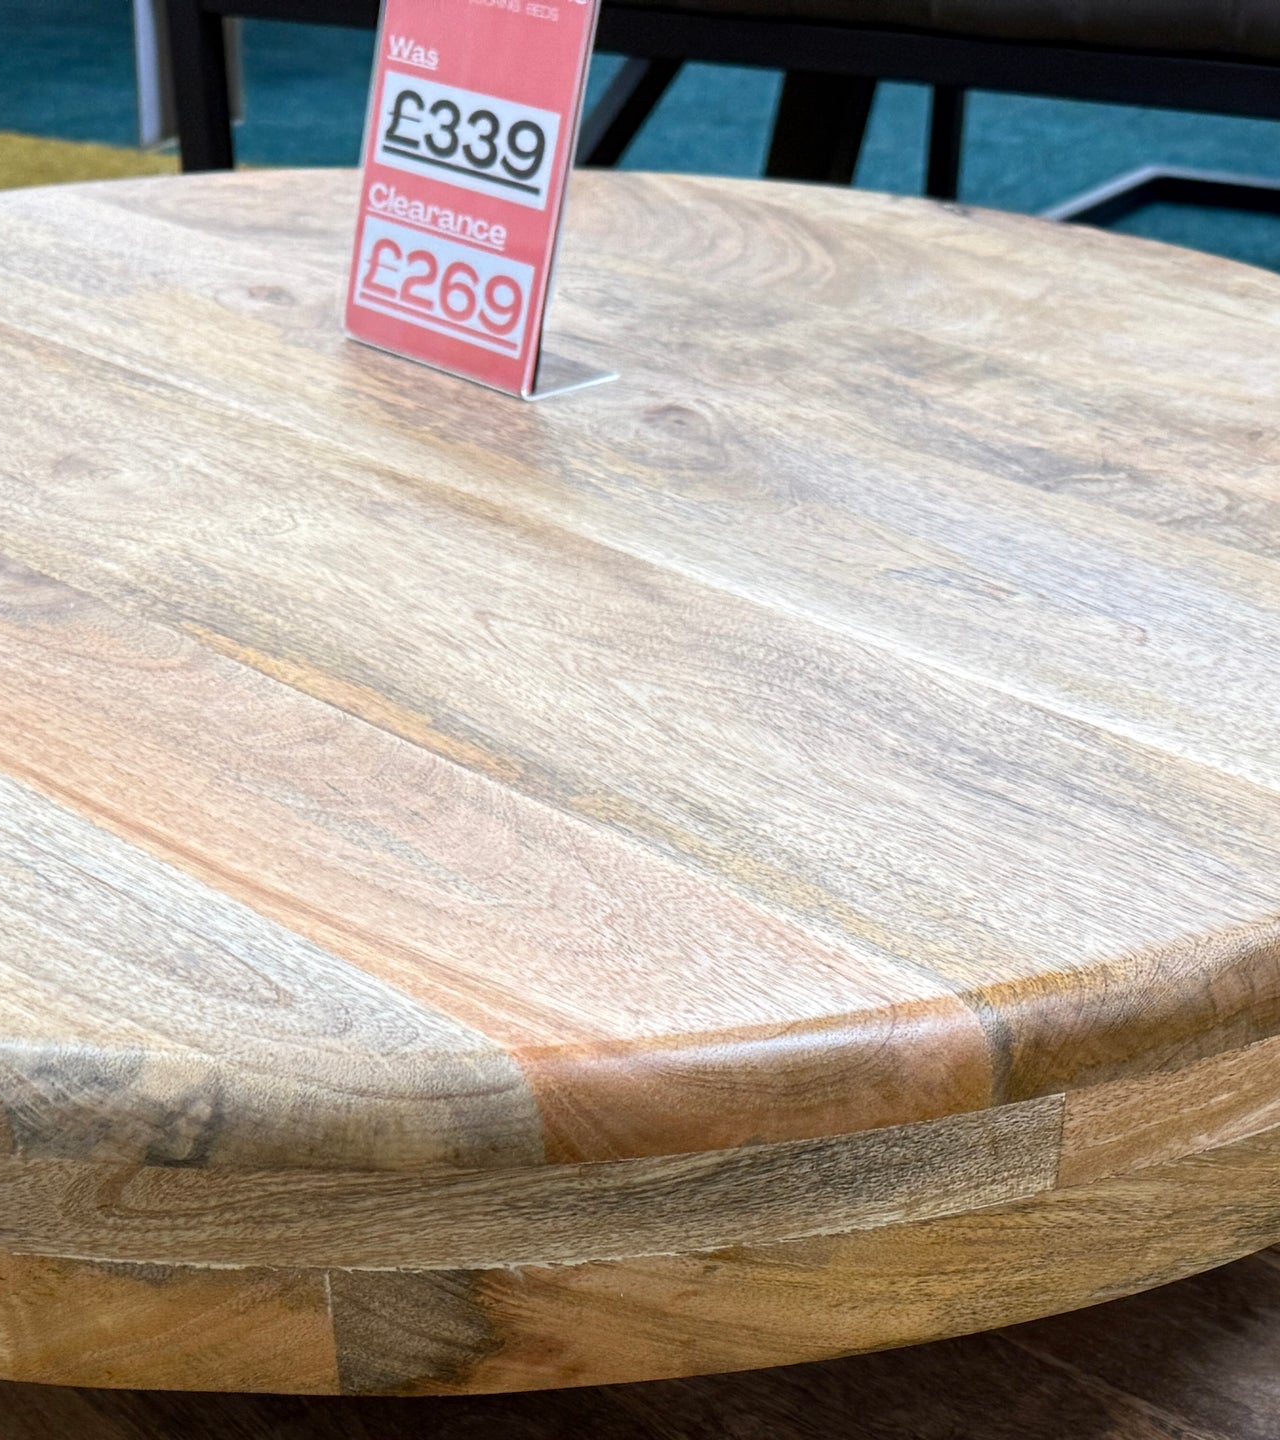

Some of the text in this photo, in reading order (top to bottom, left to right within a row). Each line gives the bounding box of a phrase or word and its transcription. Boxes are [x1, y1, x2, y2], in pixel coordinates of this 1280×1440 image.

[388, 35, 440, 66] Was
[386, 89, 546, 181] £339
[368, 182, 508, 246] Clearance
[361, 238, 523, 336] £269
